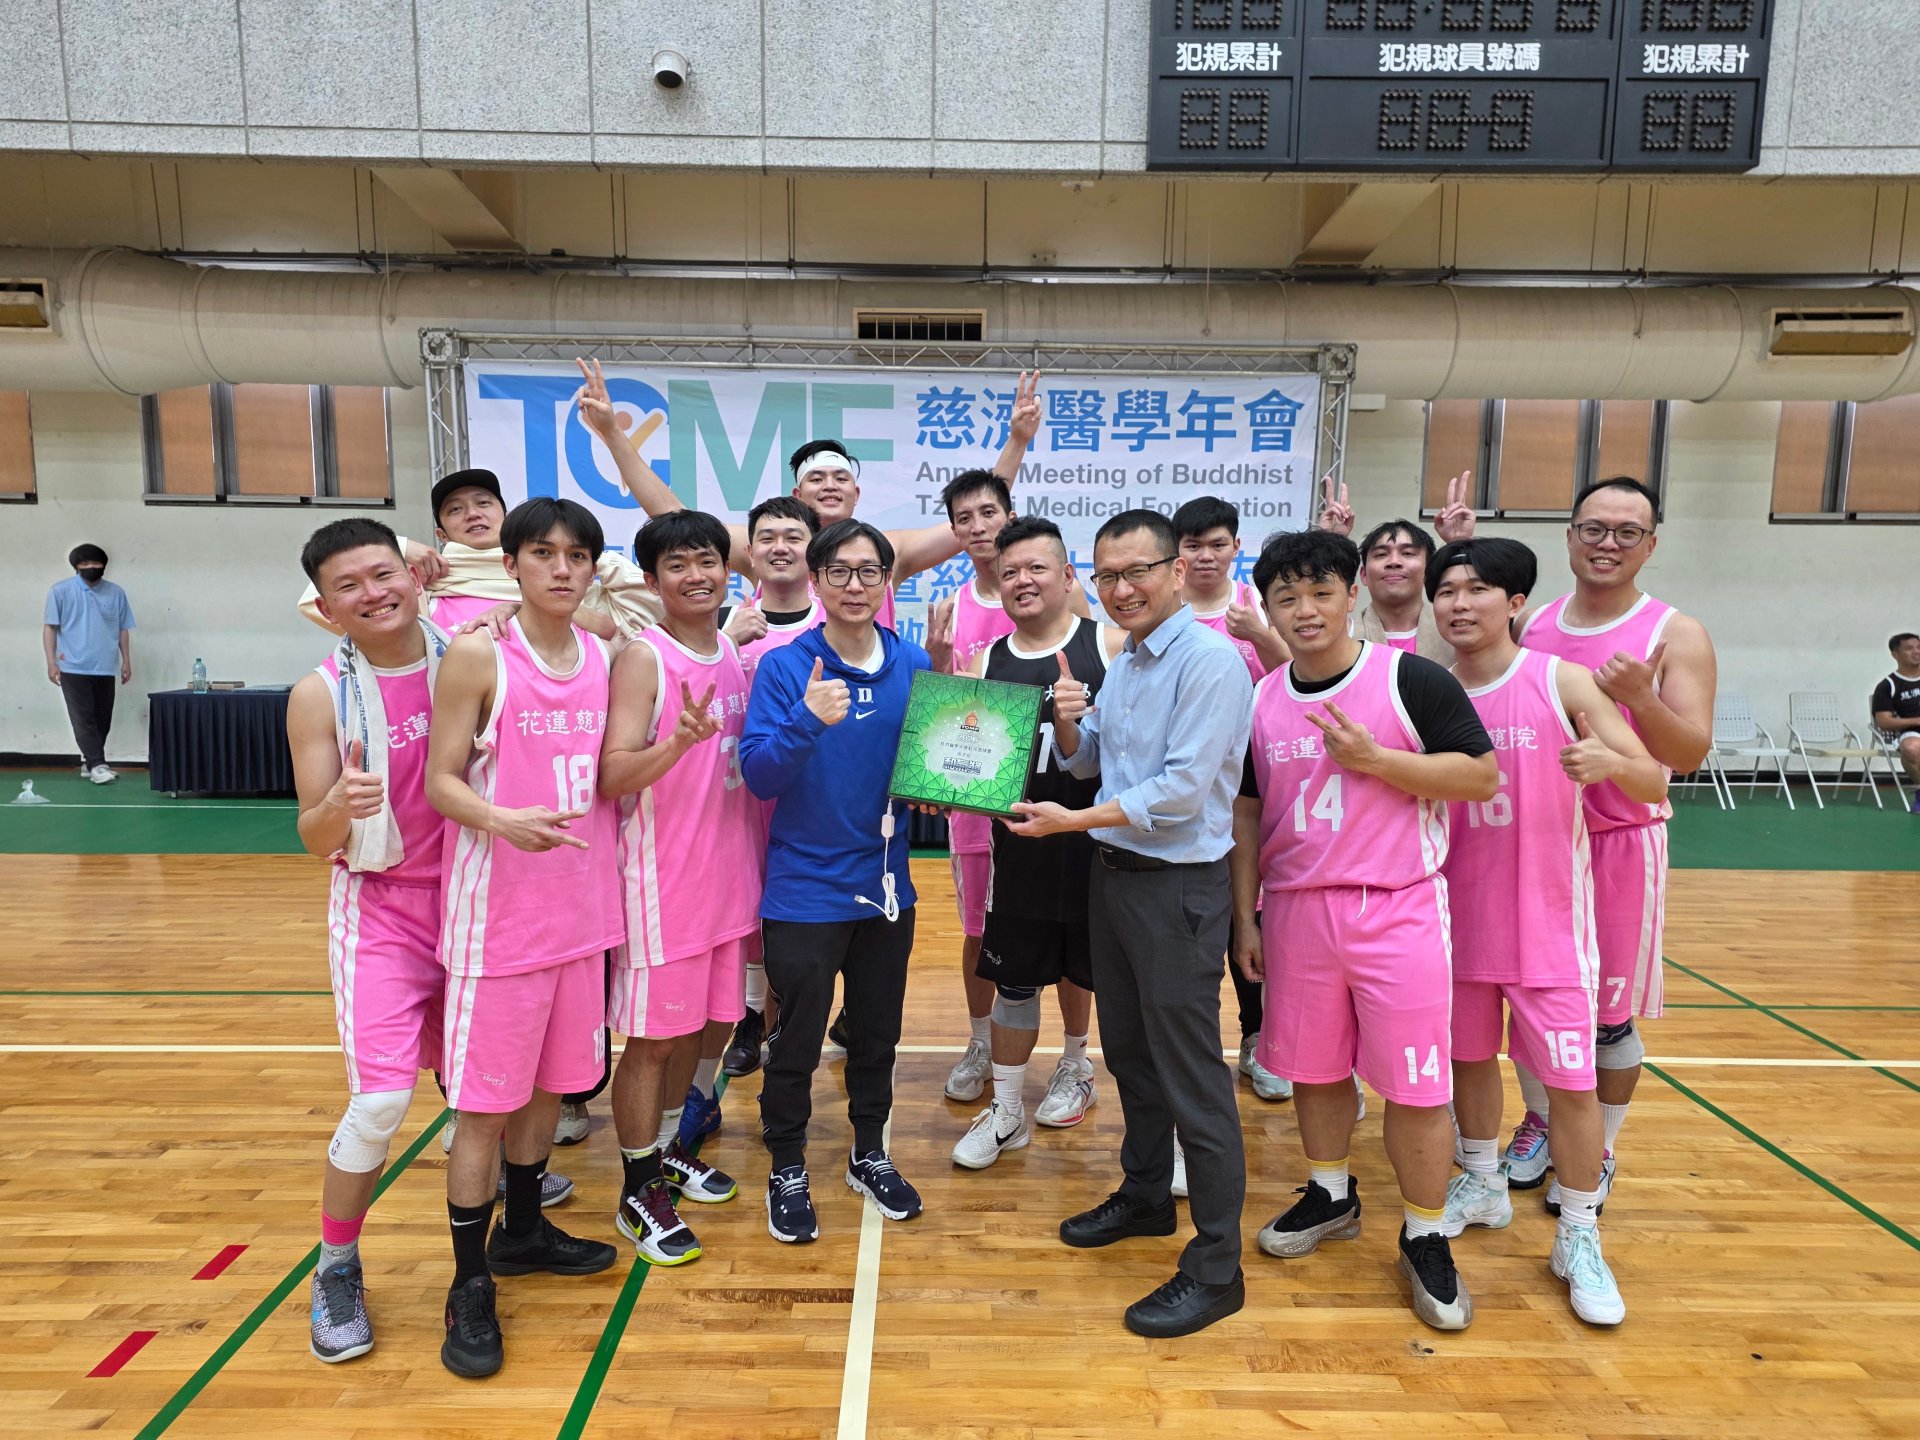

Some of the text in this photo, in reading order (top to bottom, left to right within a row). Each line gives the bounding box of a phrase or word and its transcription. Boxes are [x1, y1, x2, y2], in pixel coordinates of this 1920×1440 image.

[1176, 42, 1282, 71] 犯規累計
[1379, 43, 1541, 72] 犯規球員號碼
[1643, 44, 1749, 73] 犯規累計
[915, 461, 1293, 490] Ann Meeting of Buddhist
[1026, 496, 1131, 517] Medical
[1141, 497, 1292, 518] Fotion
[1265, 736, 1321, 763] 花蓮
[553, 754, 594, 812] 18
[1294, 774, 1344, 832] 14
[1404, 1044, 1440, 1085] 14
[1545, 1031, 1585, 1070] 16
